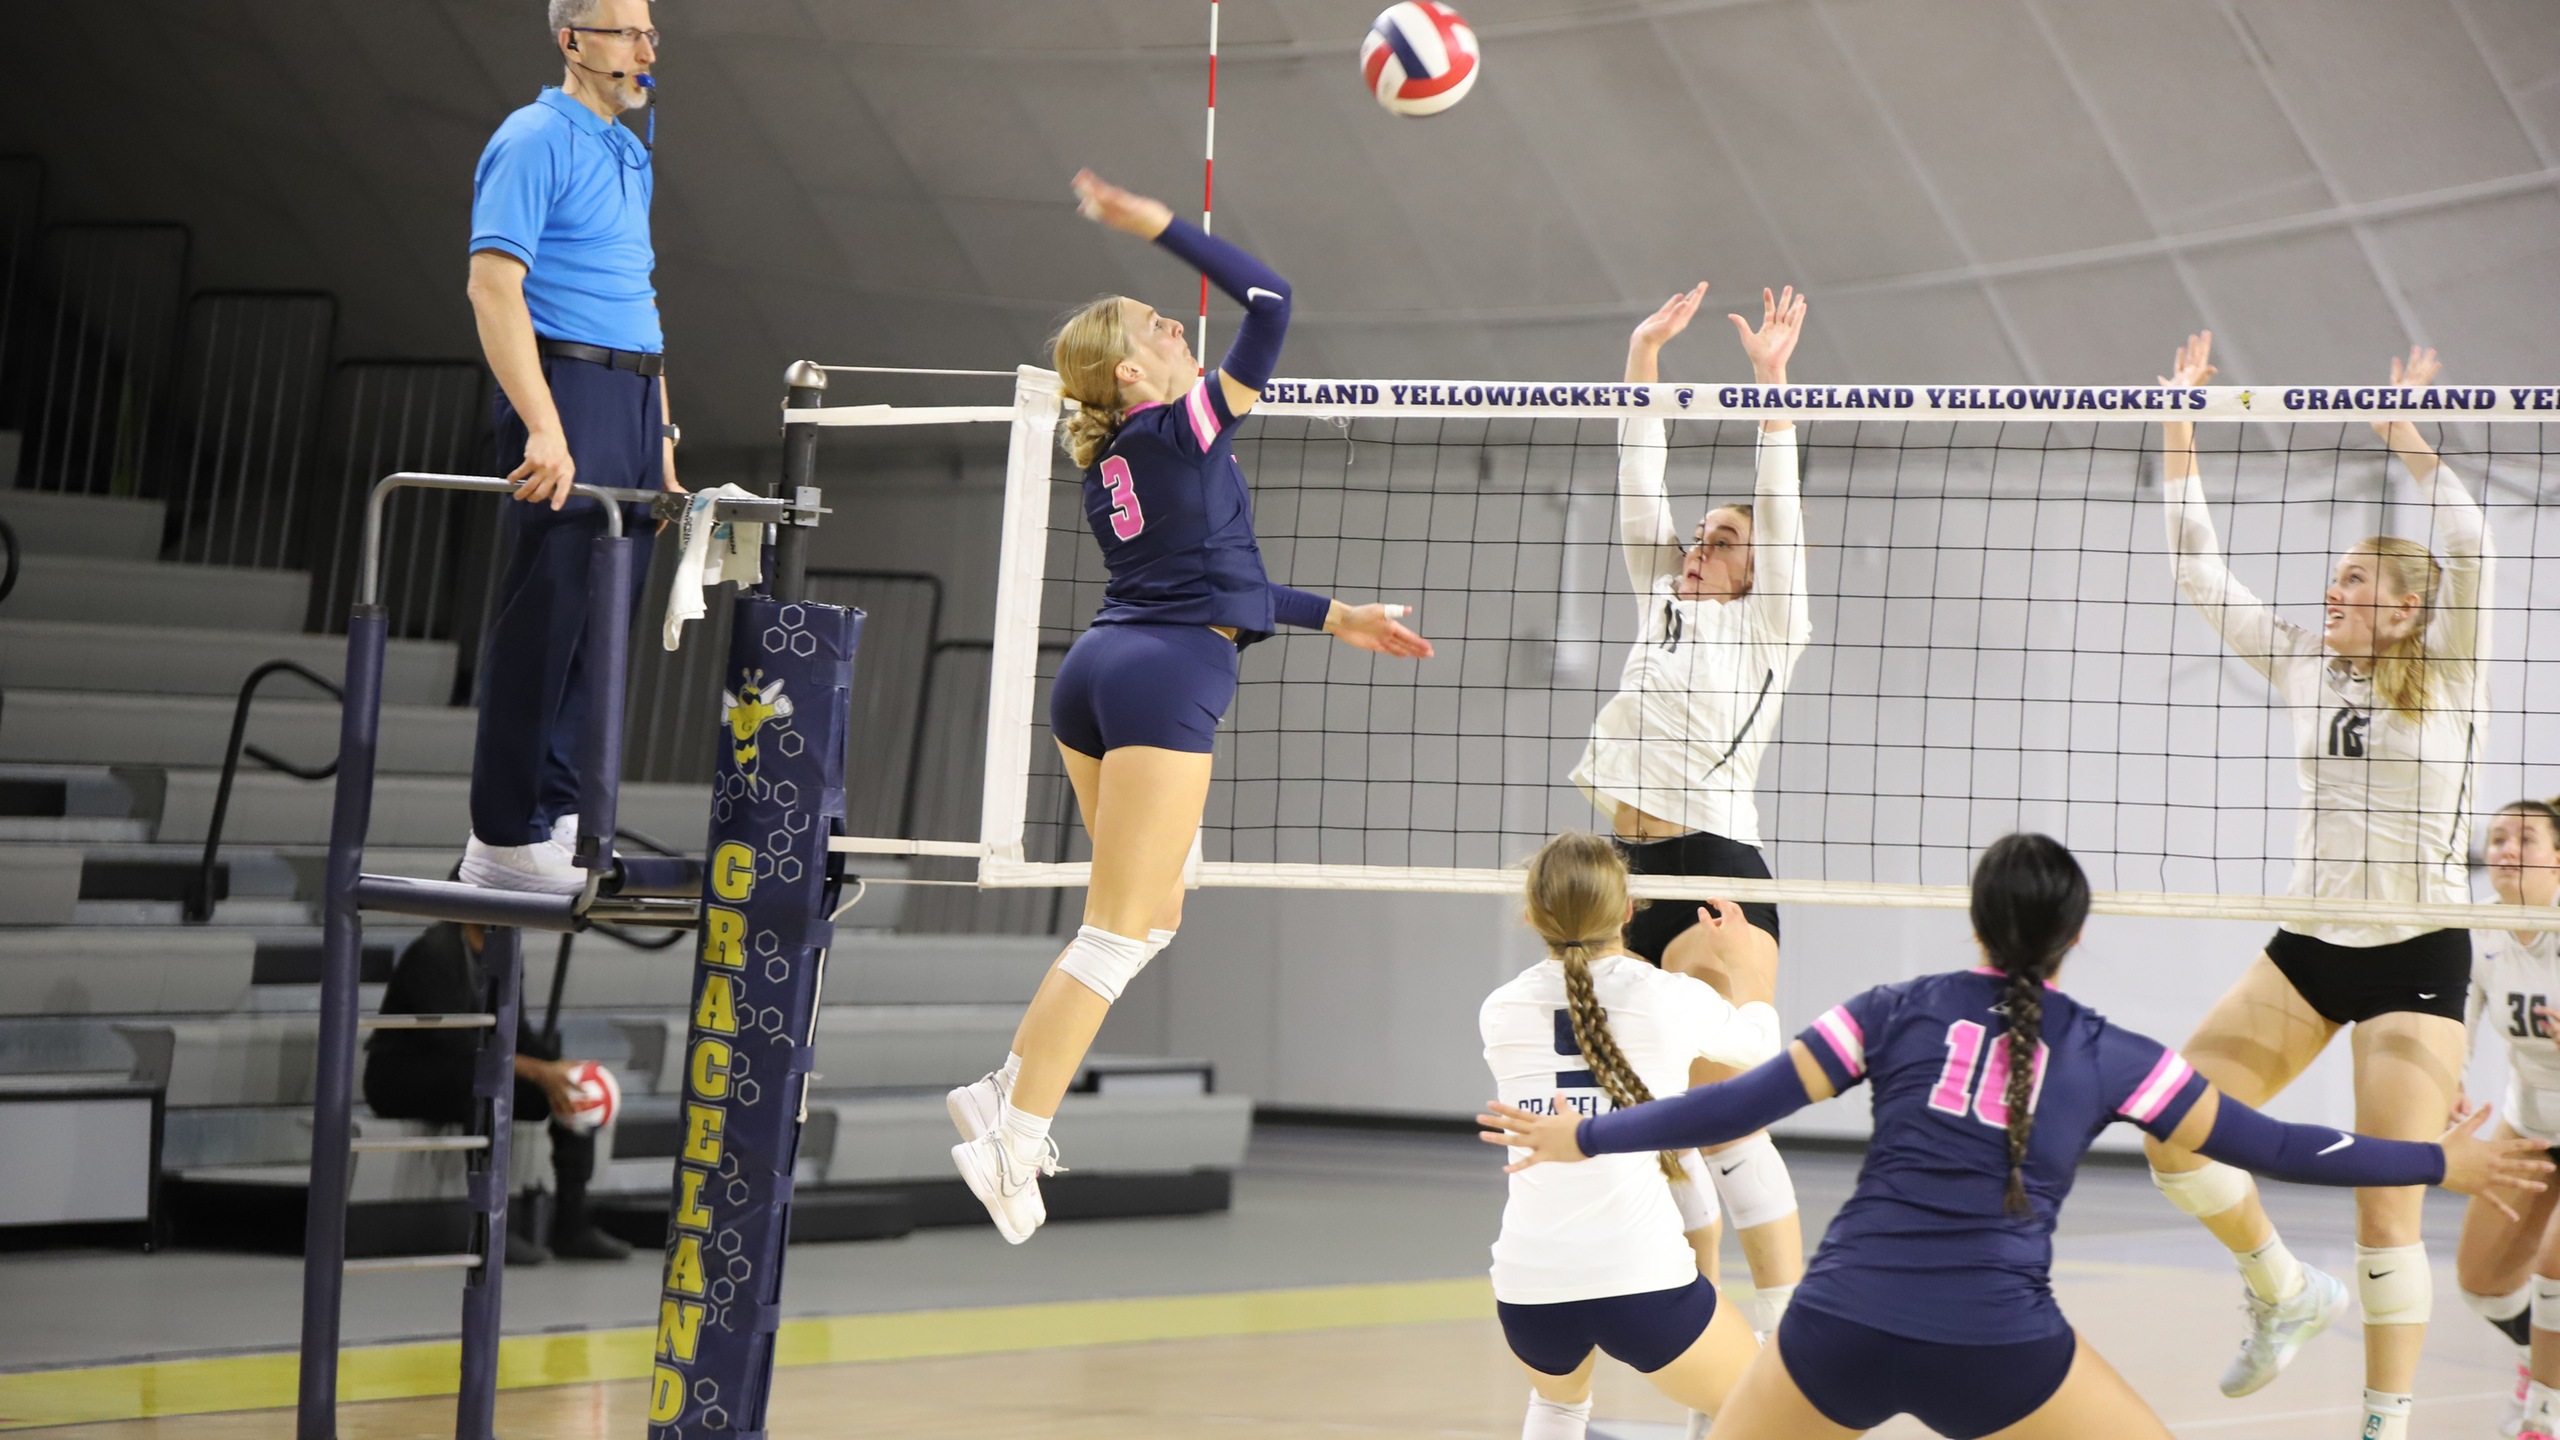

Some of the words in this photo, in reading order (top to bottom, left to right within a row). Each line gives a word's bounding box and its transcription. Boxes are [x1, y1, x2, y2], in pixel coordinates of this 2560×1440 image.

[1257, 383, 1379, 405] CELAND
[1391, 384, 1651, 408] YELLOWJACKETS
[1718, 387, 1914, 409] GRACELAND
[1926, 387, 2208, 411] YELLOWJACKETS
[2283, 388, 2497, 410] GRACELAND
[2509, 388, 2560, 410] YE
[1100, 454, 1146, 542] 3
[1927, 1018, 2050, 1129] 10
[648, 840, 757, 1427] GRACELAND
